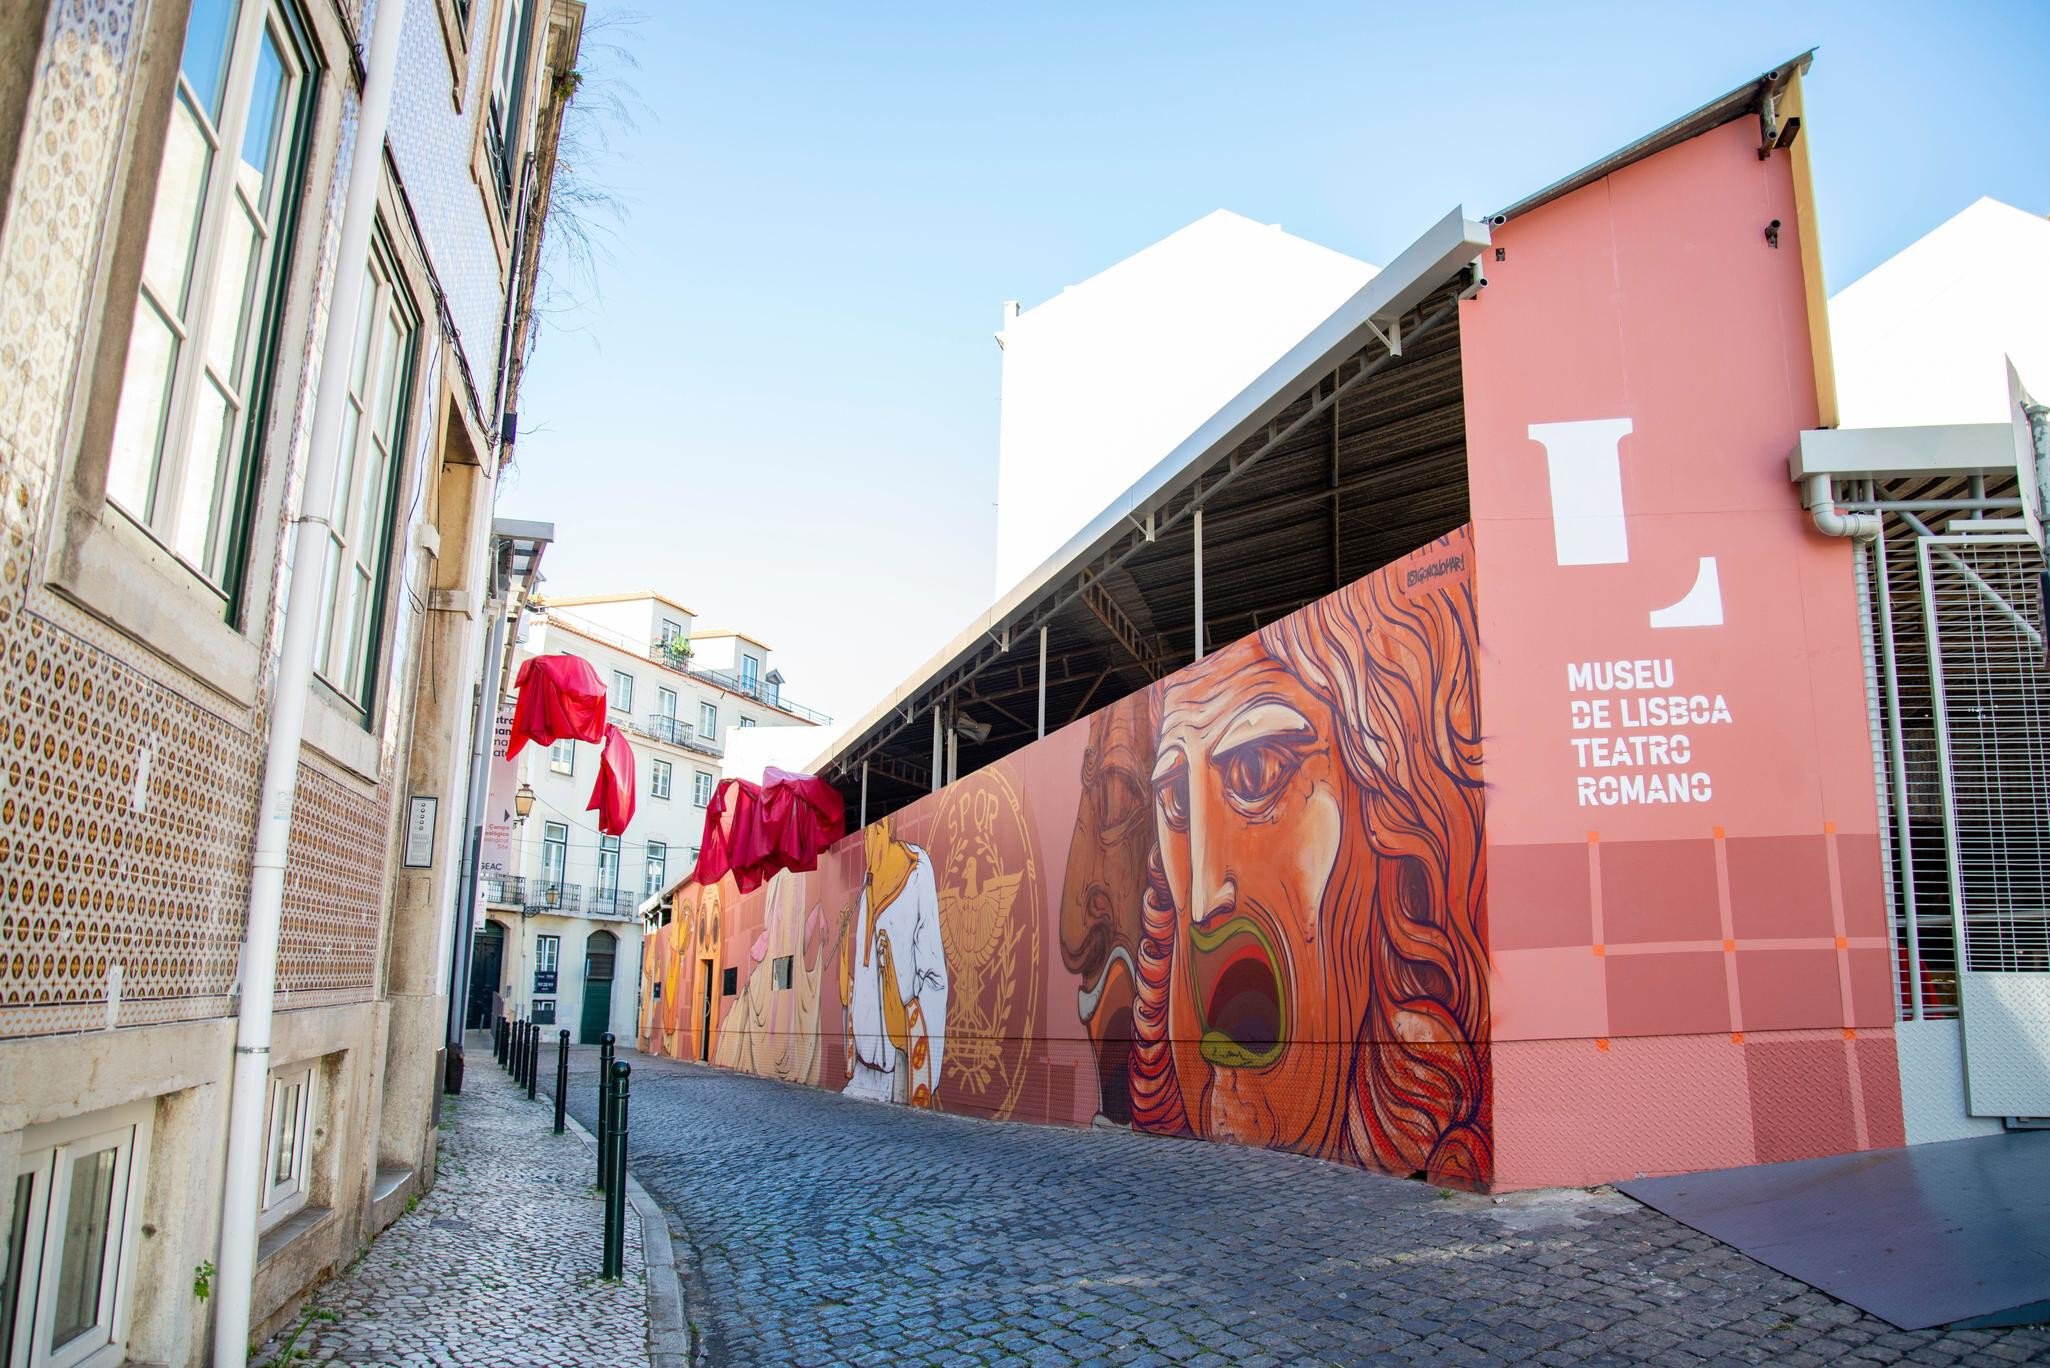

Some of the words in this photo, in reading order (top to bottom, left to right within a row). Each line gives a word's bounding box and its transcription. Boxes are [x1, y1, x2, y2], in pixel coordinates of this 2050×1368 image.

[1567, 659, 1675, 692] MUSEU
[1571, 699, 1612, 729] DE
[1620, 694, 1733, 728] LISBOA
[1571, 734, 1691, 768] TEATRO
[1577, 772, 1712, 806] ROMANO
